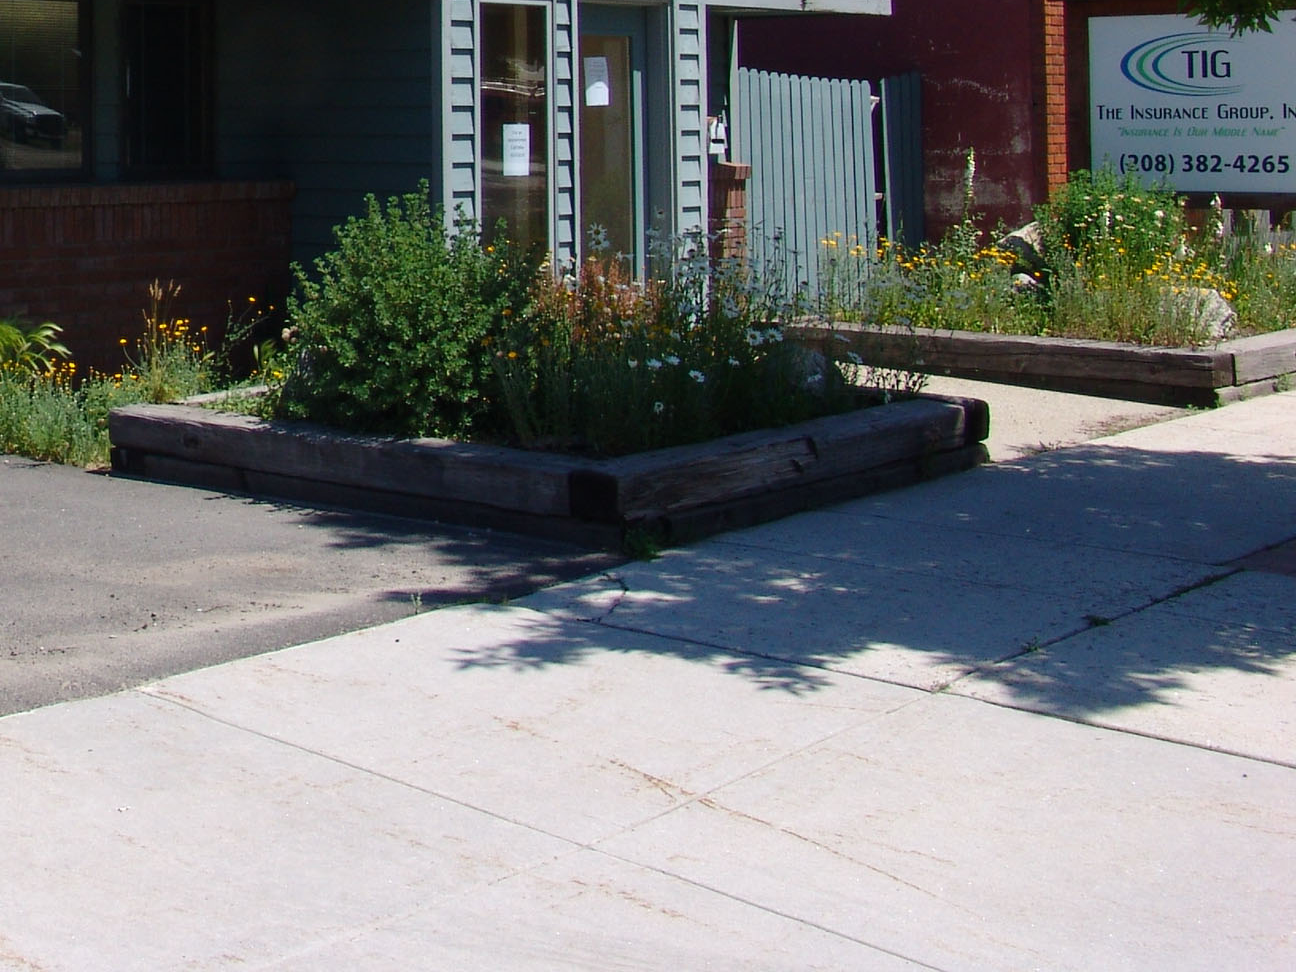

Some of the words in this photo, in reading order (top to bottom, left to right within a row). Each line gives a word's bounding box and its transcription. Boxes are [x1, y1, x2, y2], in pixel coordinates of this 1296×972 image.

[1181, 49, 1231, 79] TIG
[1096, 105, 1123, 121] THE
[1130, 104, 1209, 120] INSURANCE
[1119, 153, 1175, 175] (208)
[1181, 154, 1290, 174] 382-4265
